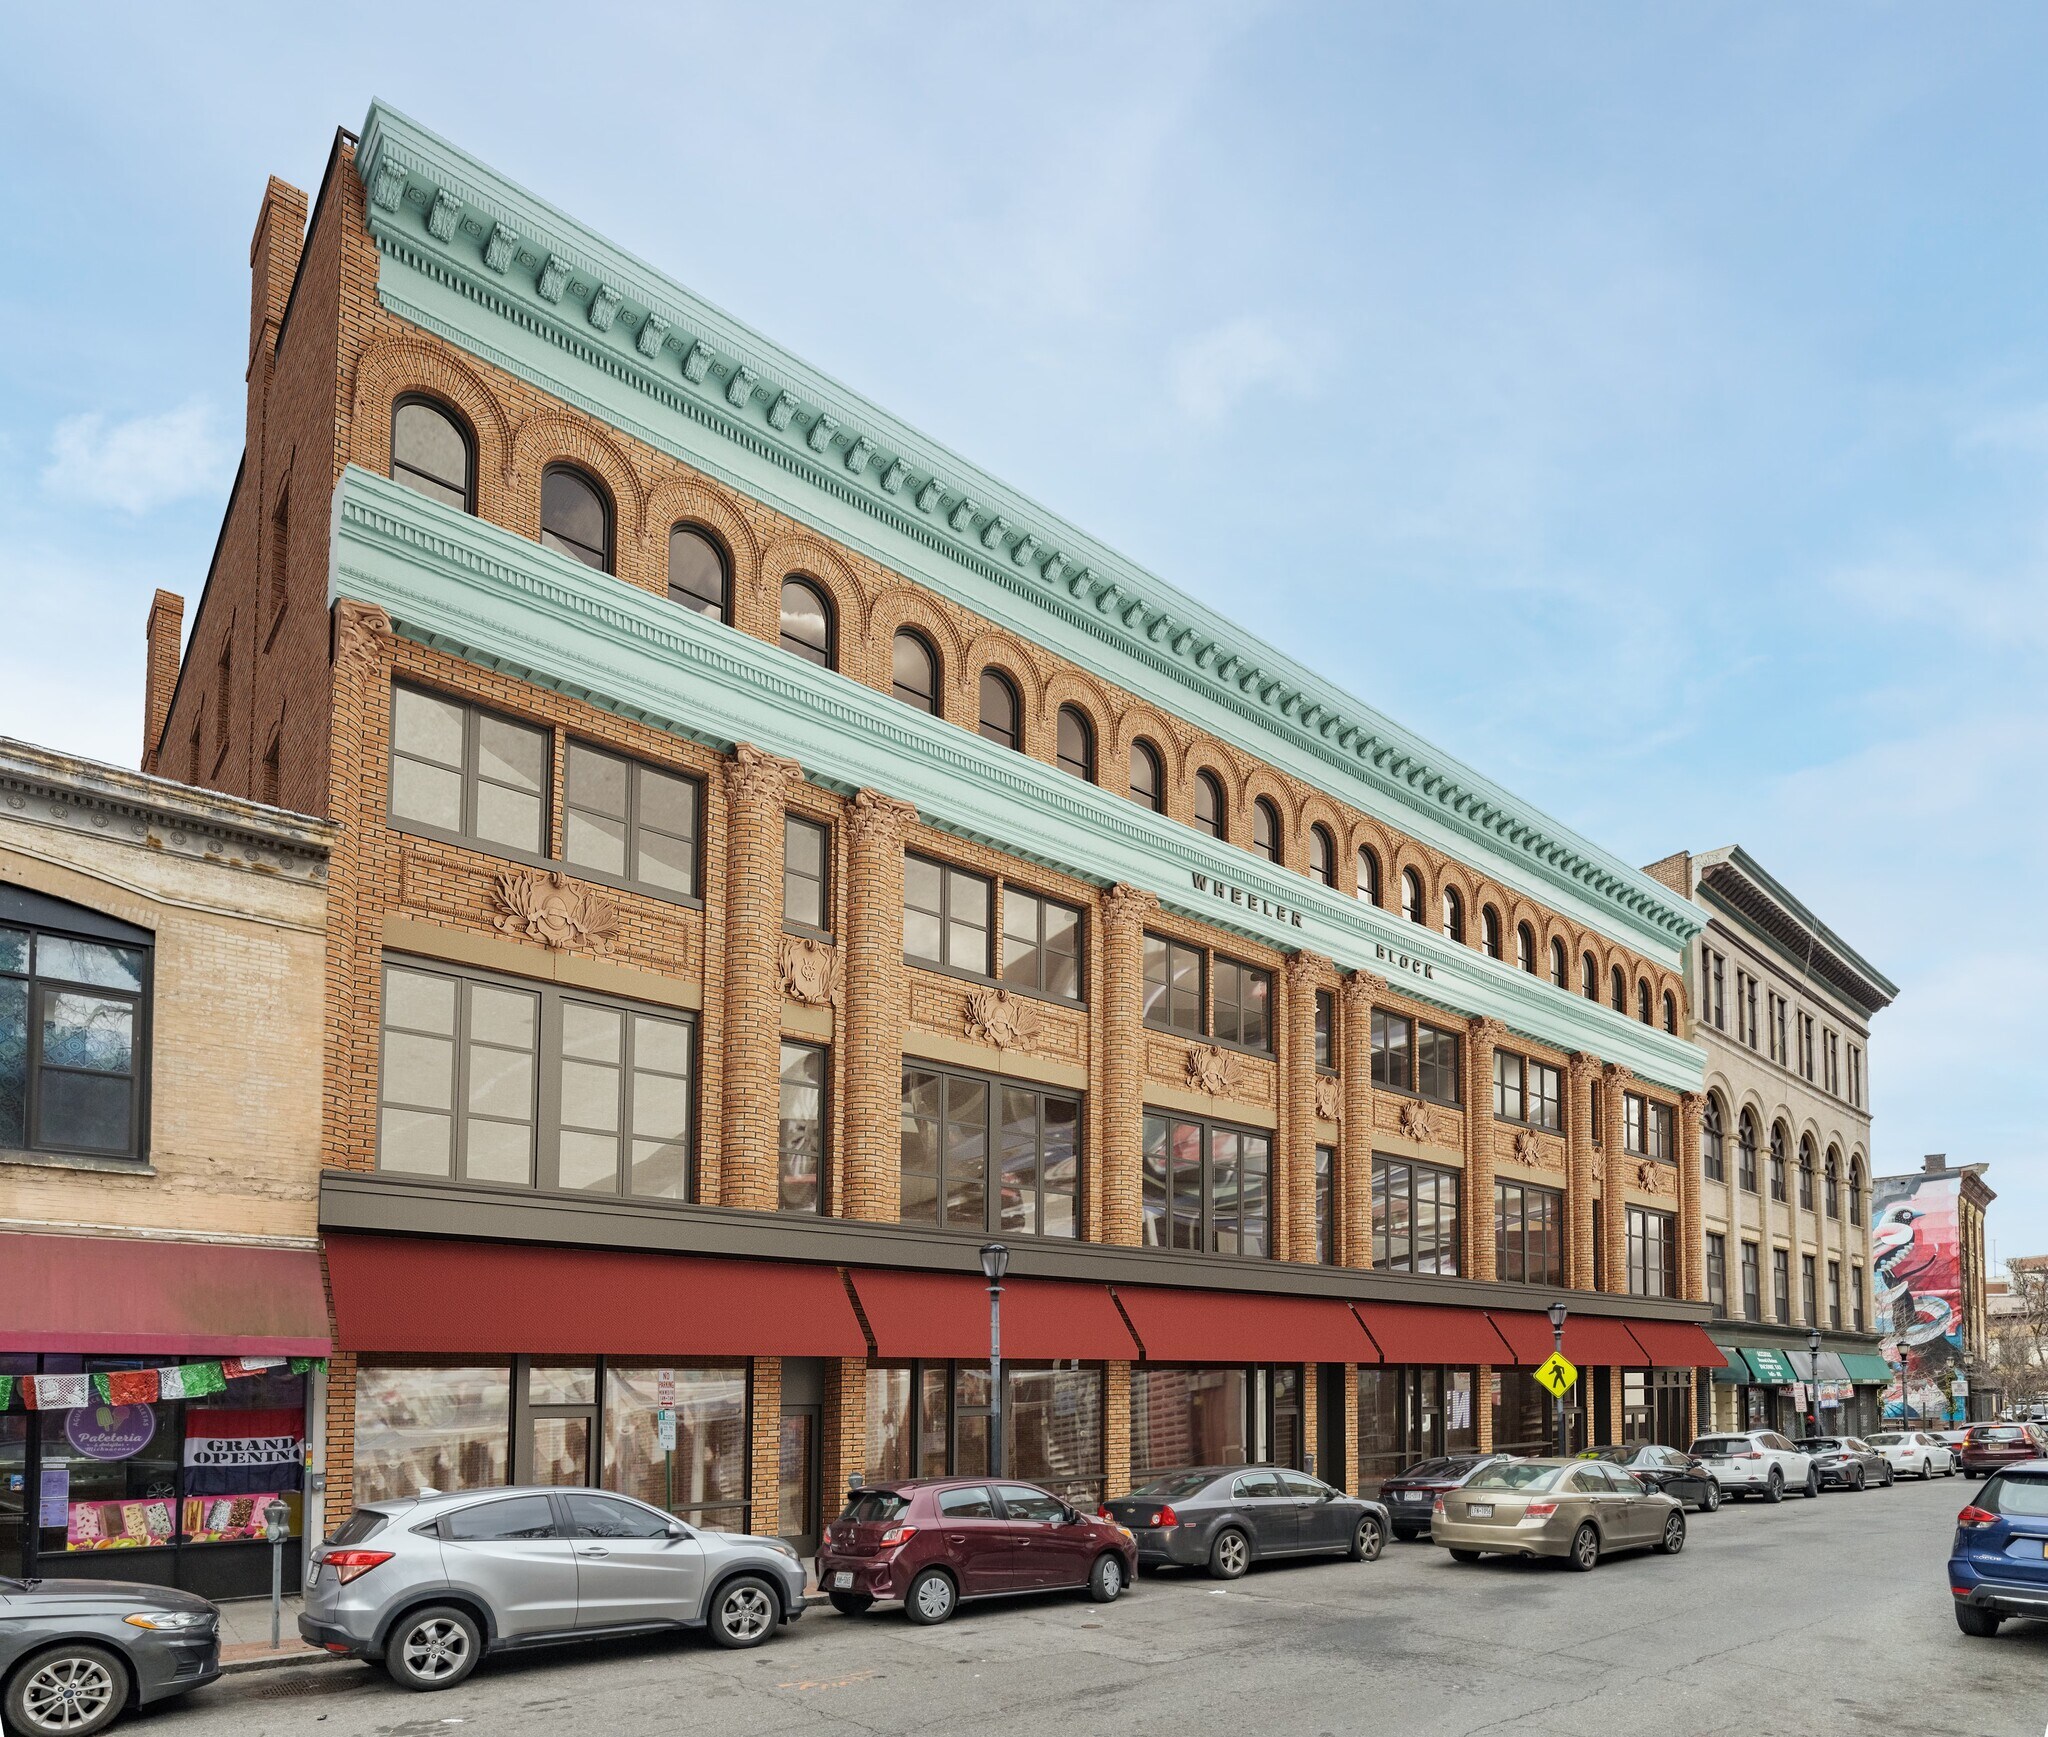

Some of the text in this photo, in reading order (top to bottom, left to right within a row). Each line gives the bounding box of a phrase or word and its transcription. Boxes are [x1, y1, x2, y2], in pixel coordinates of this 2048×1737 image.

[1192, 872, 1433, 980] WHEELER BLOCK
[662, 1371, 670, 1380] NO
[78, 1432, 143, 1443] Paleteria
[206, 1438, 296, 1452] GRAND
